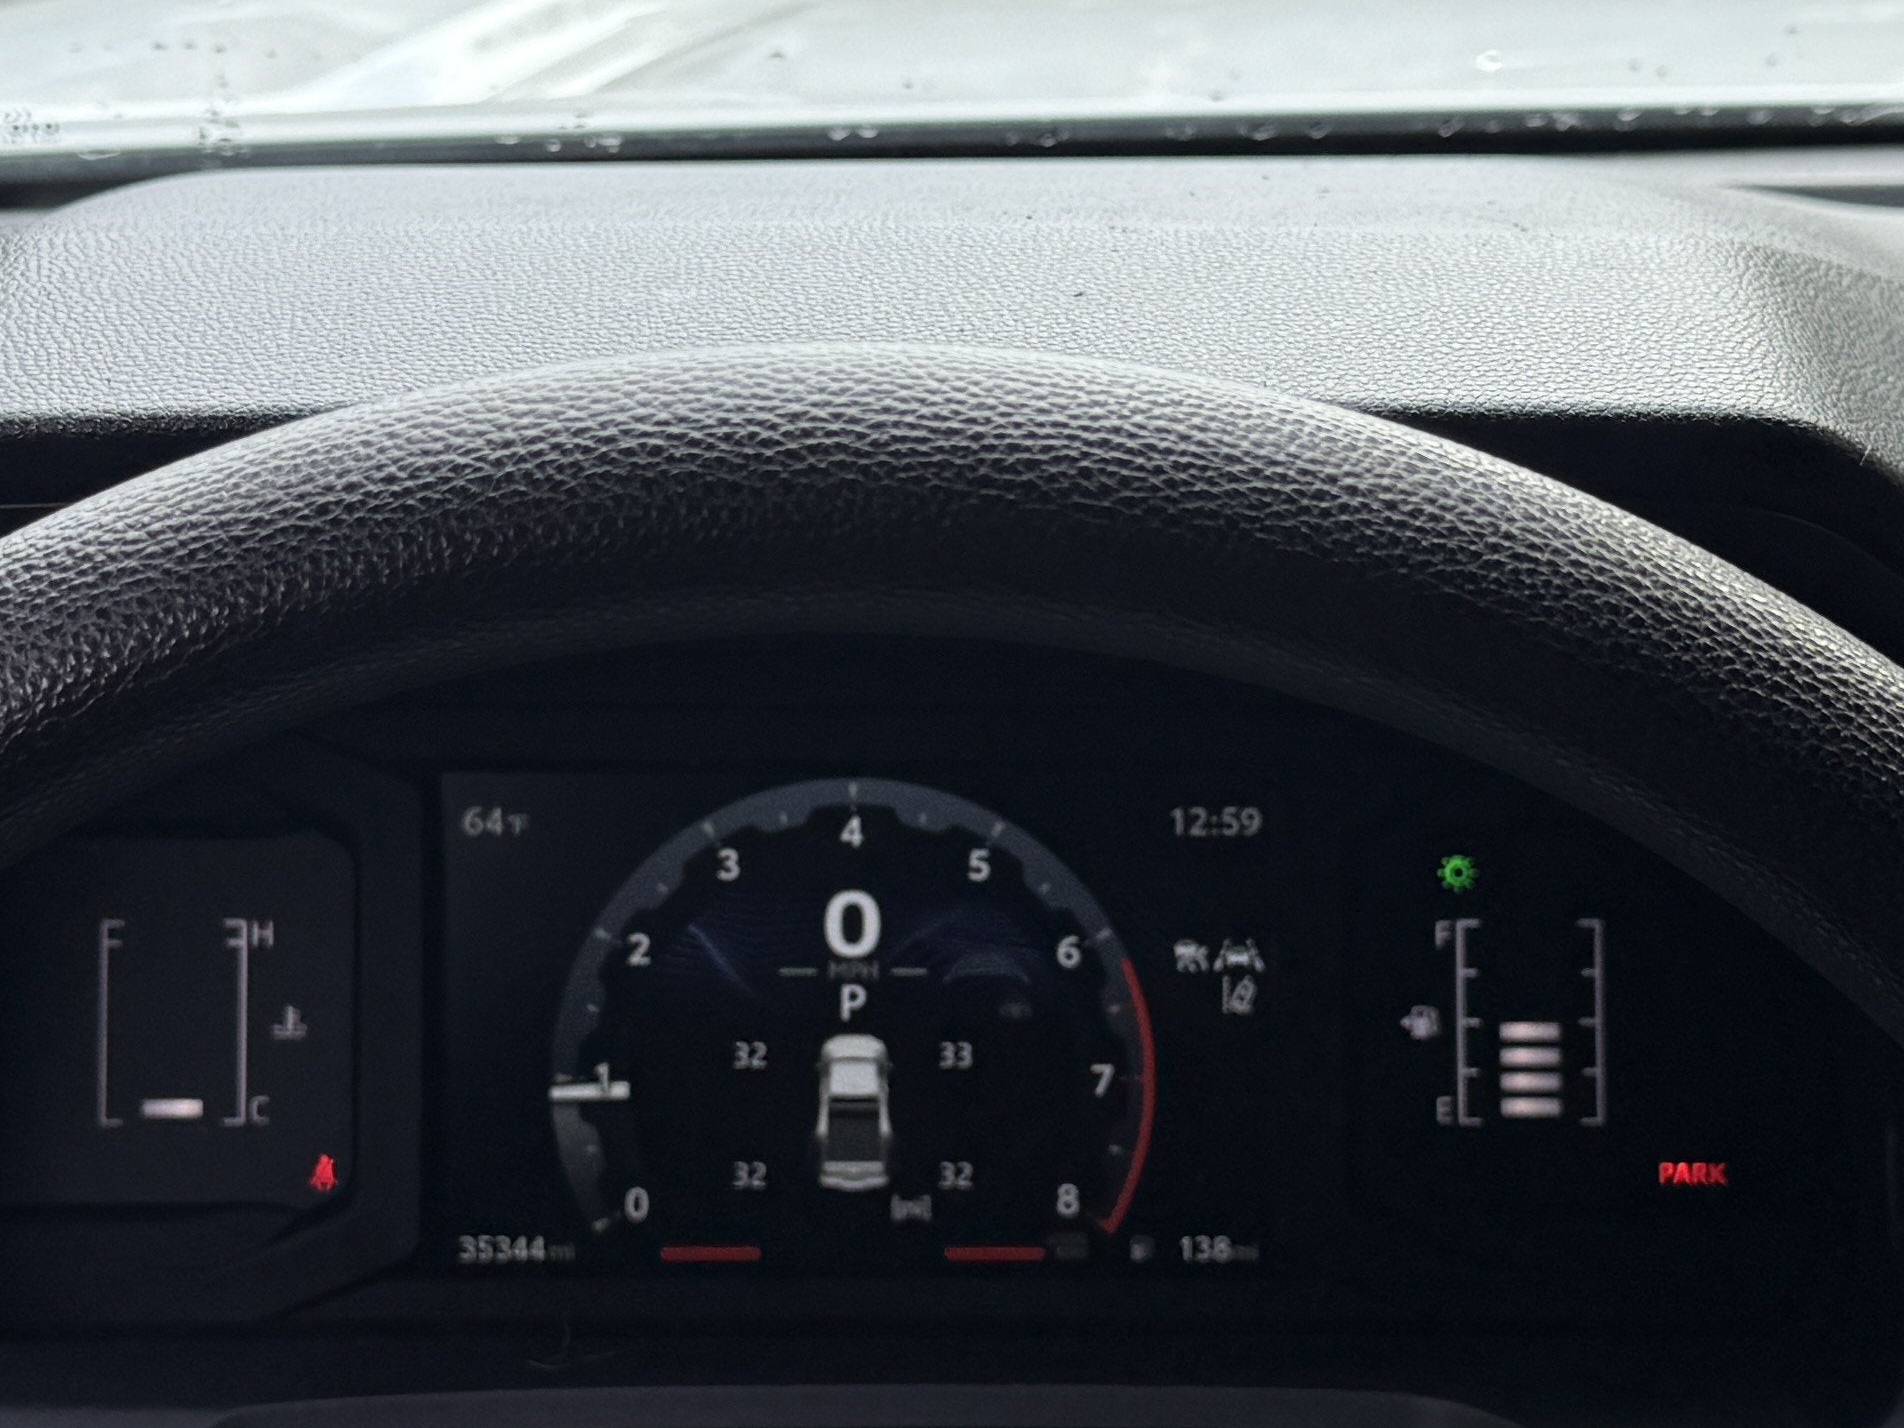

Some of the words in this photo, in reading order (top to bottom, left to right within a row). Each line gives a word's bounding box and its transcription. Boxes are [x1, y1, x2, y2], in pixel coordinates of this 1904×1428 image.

[840, 816, 863, 847] 4
[1170, 806, 1263, 837] 12:59
[717, 847, 741, 881] 3
[968, 848, 991, 882] 5
[250, 920, 274, 946] H
[824, 890, 881, 958] 0
[628, 932, 651, 966] 2
[1056, 935, 1081, 969] 6
[840, 983, 867, 1020] P
[734, 1041, 768, 1069] 32
[939, 1041, 973, 1069] 33
[595, 1062, 613, 1091] 1
[1090, 1063, 1114, 1096] 7
[248, 1095, 270, 1124] C
[1435, 1095, 1453, 1125] E
[733, 1161, 767, 1189] 32
[939, 1161, 973, 1190] 32
[1659, 1161, 1724, 1185] PARK
[624, 1186, 650, 1221] 0
[1056, 1183, 1080, 1216] 8
